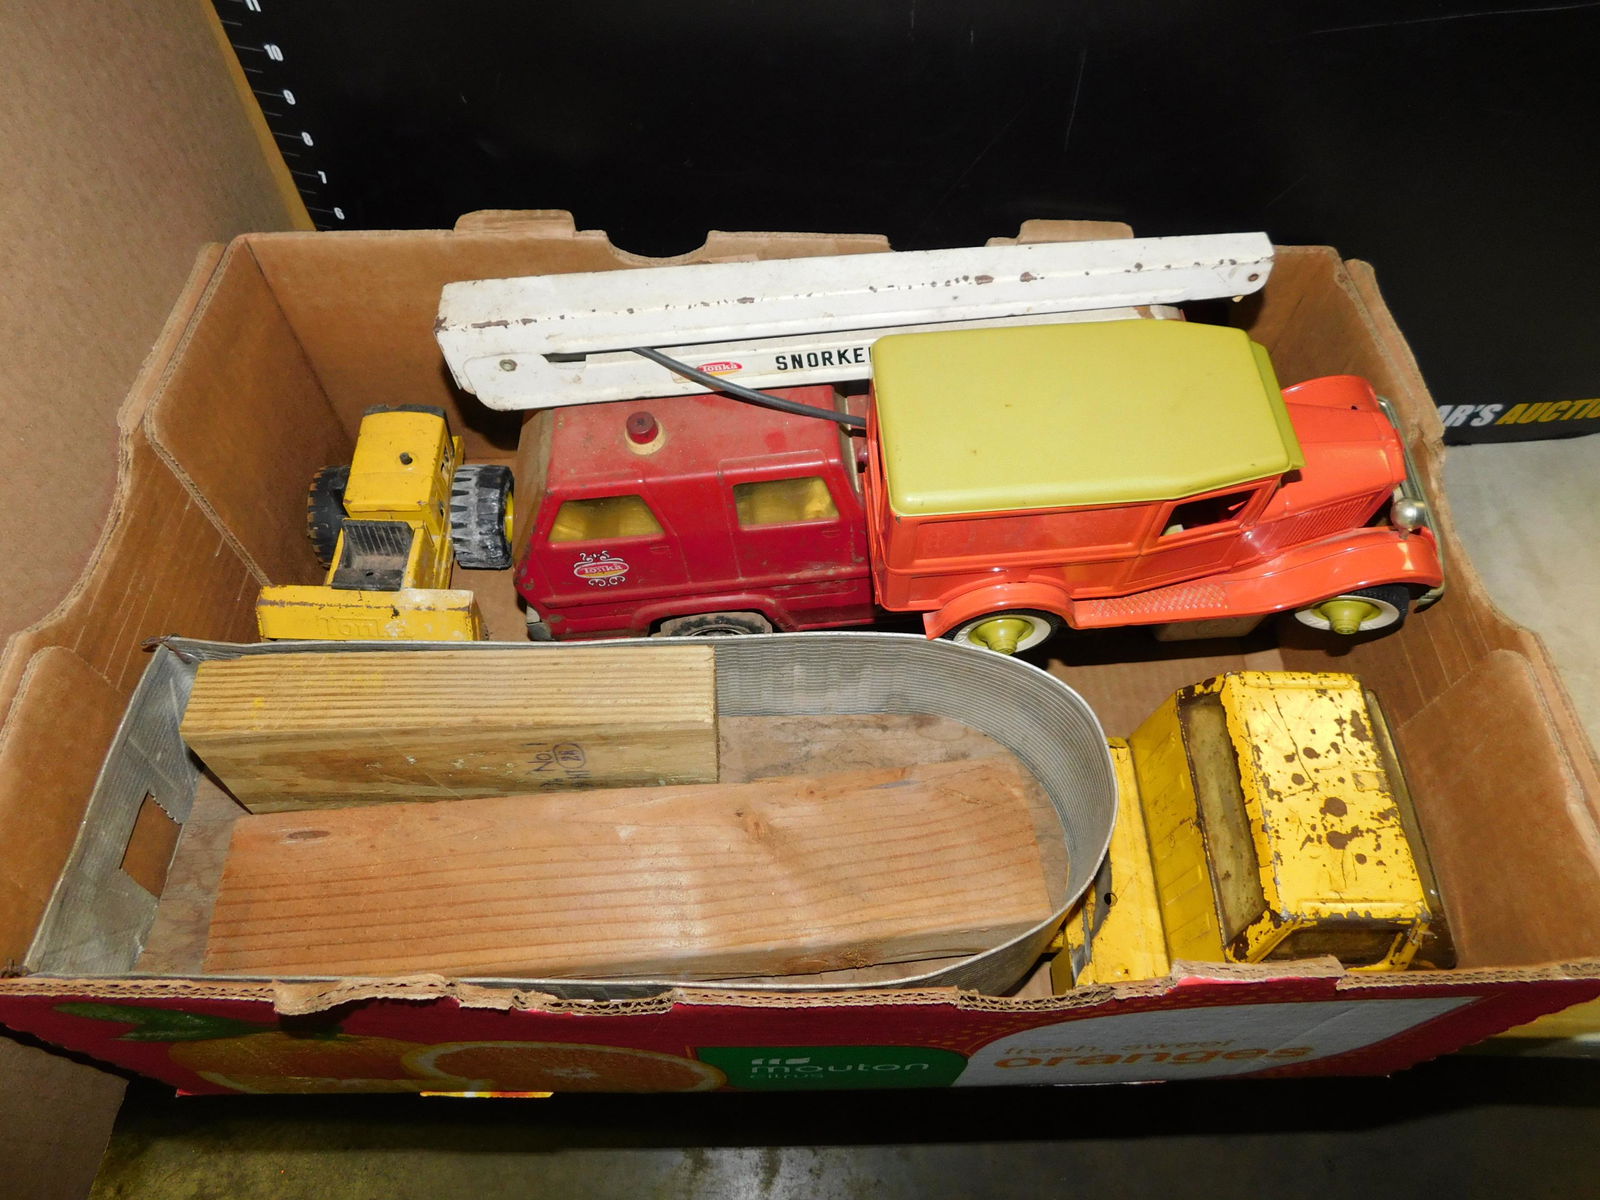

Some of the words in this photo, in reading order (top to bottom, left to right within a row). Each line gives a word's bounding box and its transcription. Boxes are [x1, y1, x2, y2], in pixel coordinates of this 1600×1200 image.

[264, 44, 284, 62] 10
[283, 89, 296, 105] 9
[301, 131, 314, 146] 8
[317, 170, 328, 184] 7
[333, 207, 345, 220] 6
[583, 564, 622, 574] Tonka
[1122, 1039, 1236, 1051] sweet
[993, 1046, 1314, 1069] oranges
[751, 1060, 929, 1073] mouton
